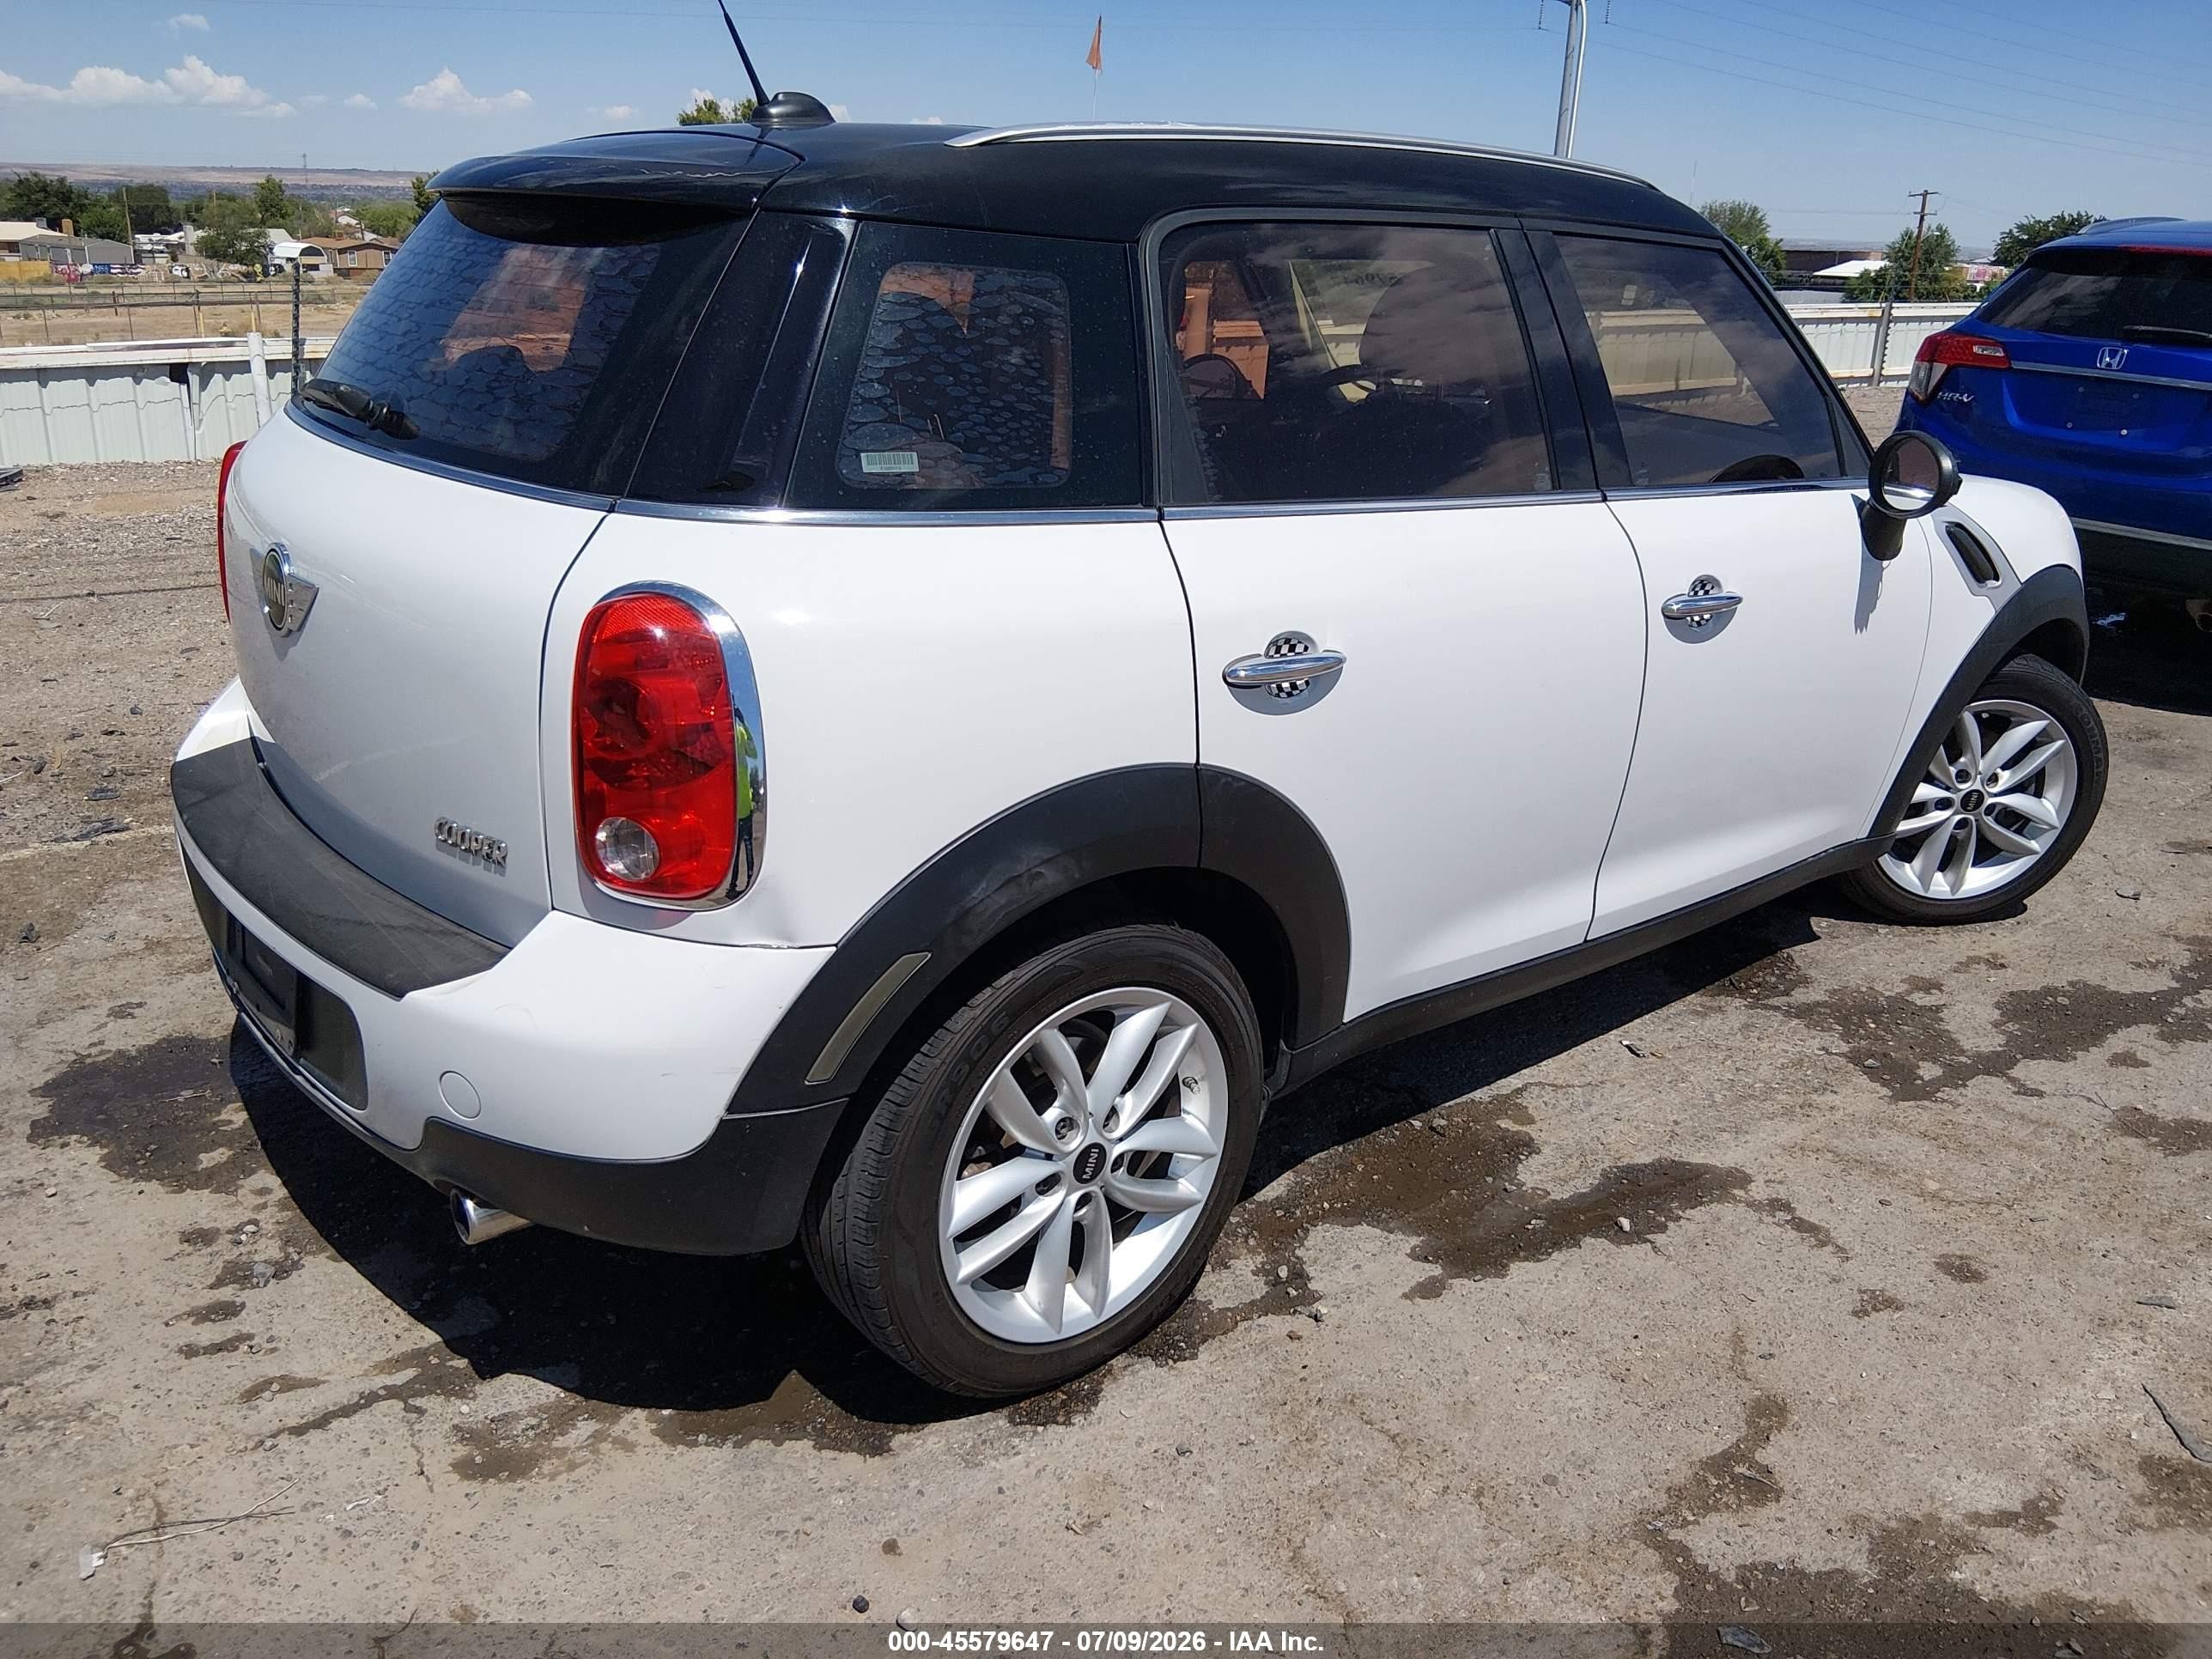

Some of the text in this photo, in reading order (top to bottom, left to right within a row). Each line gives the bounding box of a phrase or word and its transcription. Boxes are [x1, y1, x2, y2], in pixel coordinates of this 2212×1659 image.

[1966, 792, 1978, 810] MINI
[434, 817, 508, 868] COOPER
[1082, 1148, 1099, 1179] MINI
